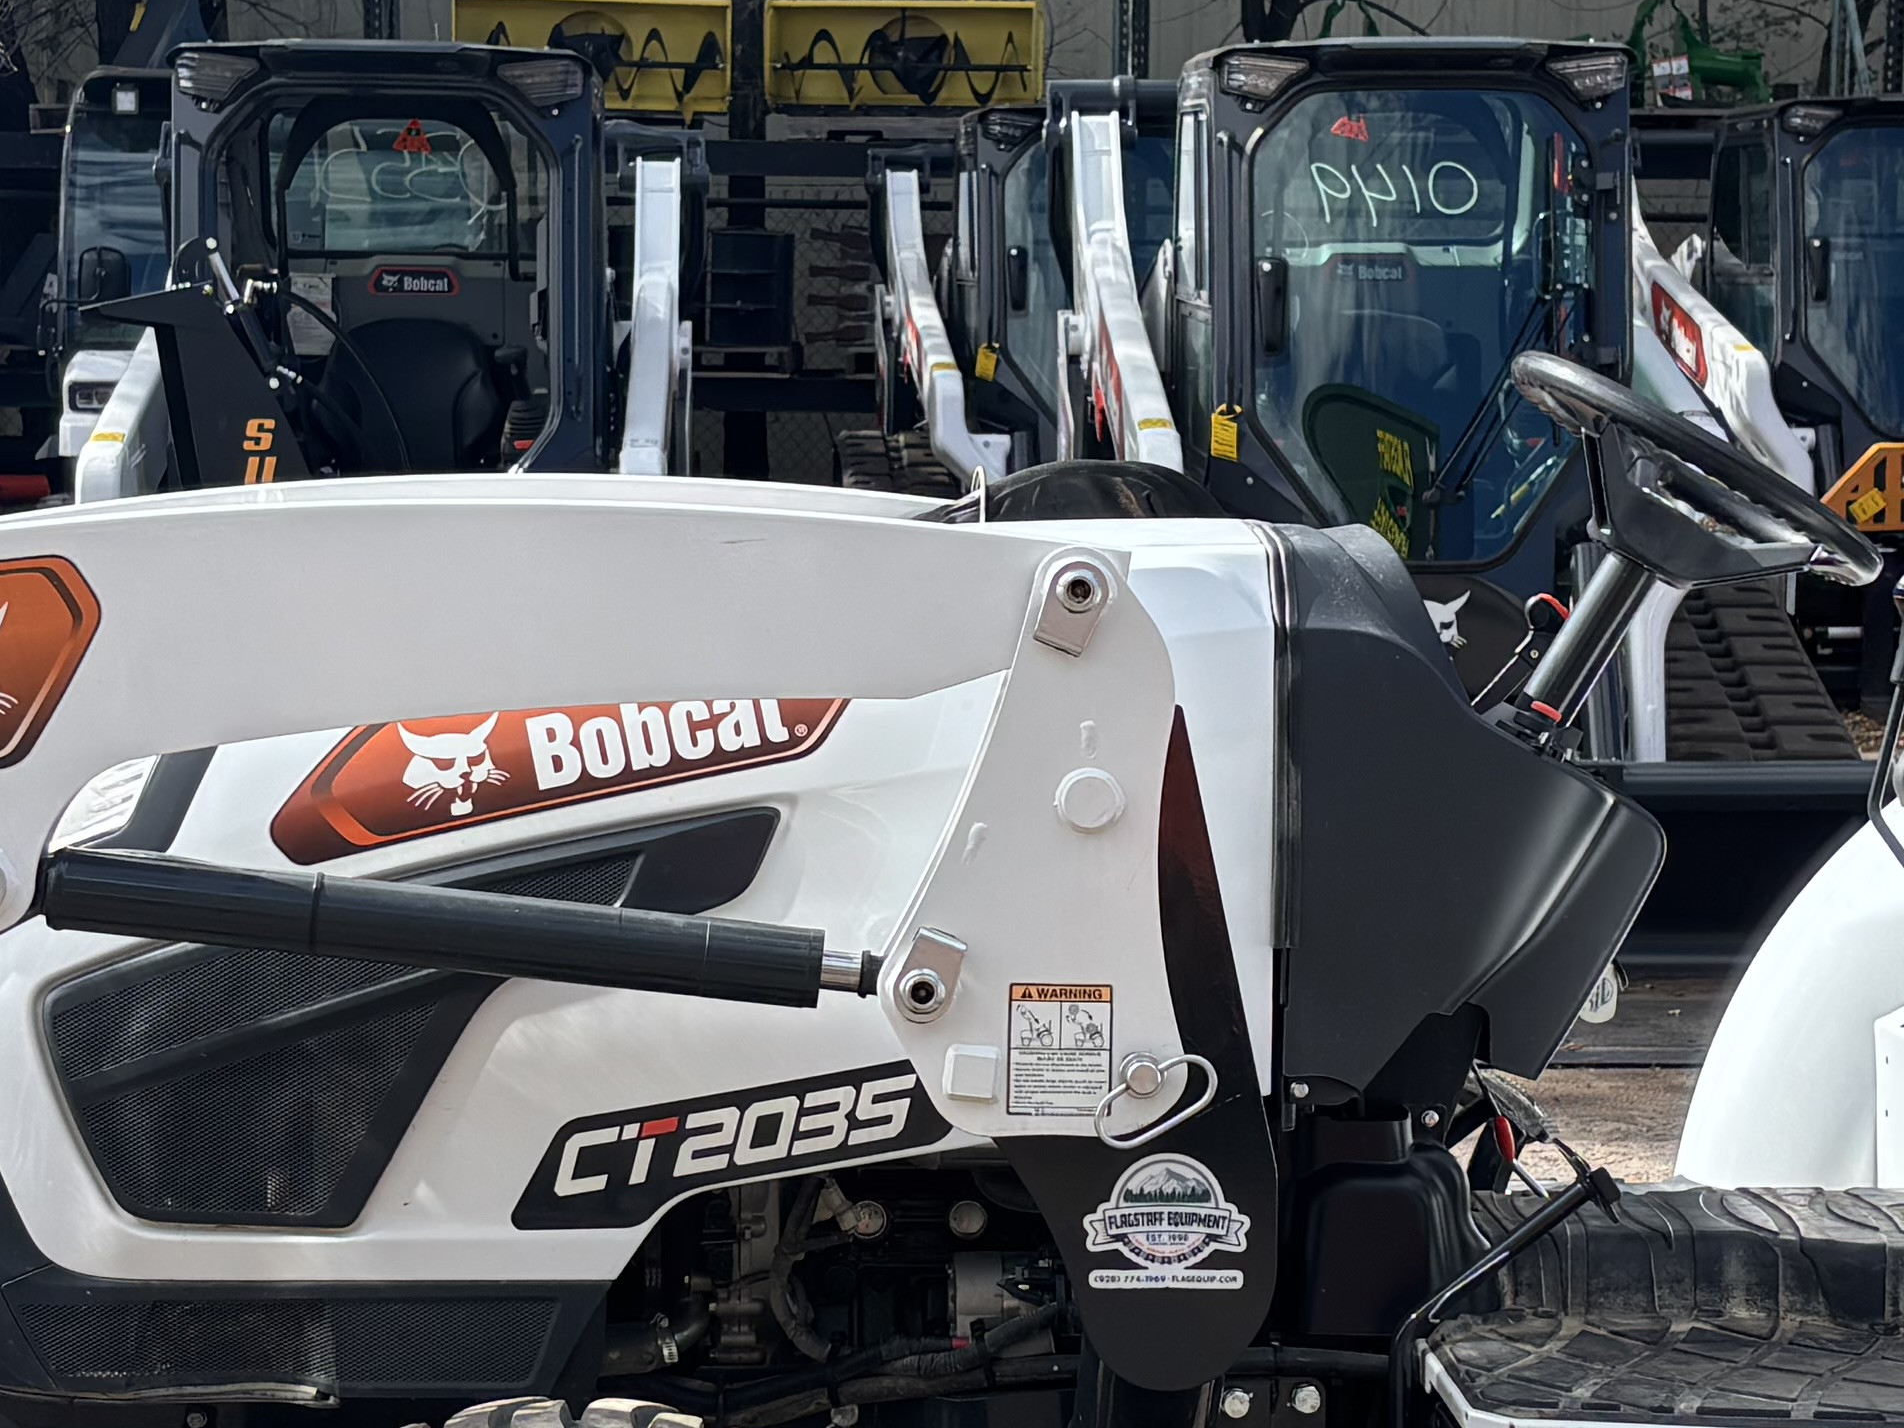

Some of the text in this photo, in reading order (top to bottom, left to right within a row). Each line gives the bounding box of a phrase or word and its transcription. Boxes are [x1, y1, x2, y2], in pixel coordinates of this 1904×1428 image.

[404, 276, 448, 292] Bobcat
[524, 698, 789, 792] Bobcat
[1036, 988, 1103, 999] WARNING
[553, 1073, 919, 1197] CT2035
[1108, 1211, 1228, 1230] FLAGSTAFF EQUIPMENT
